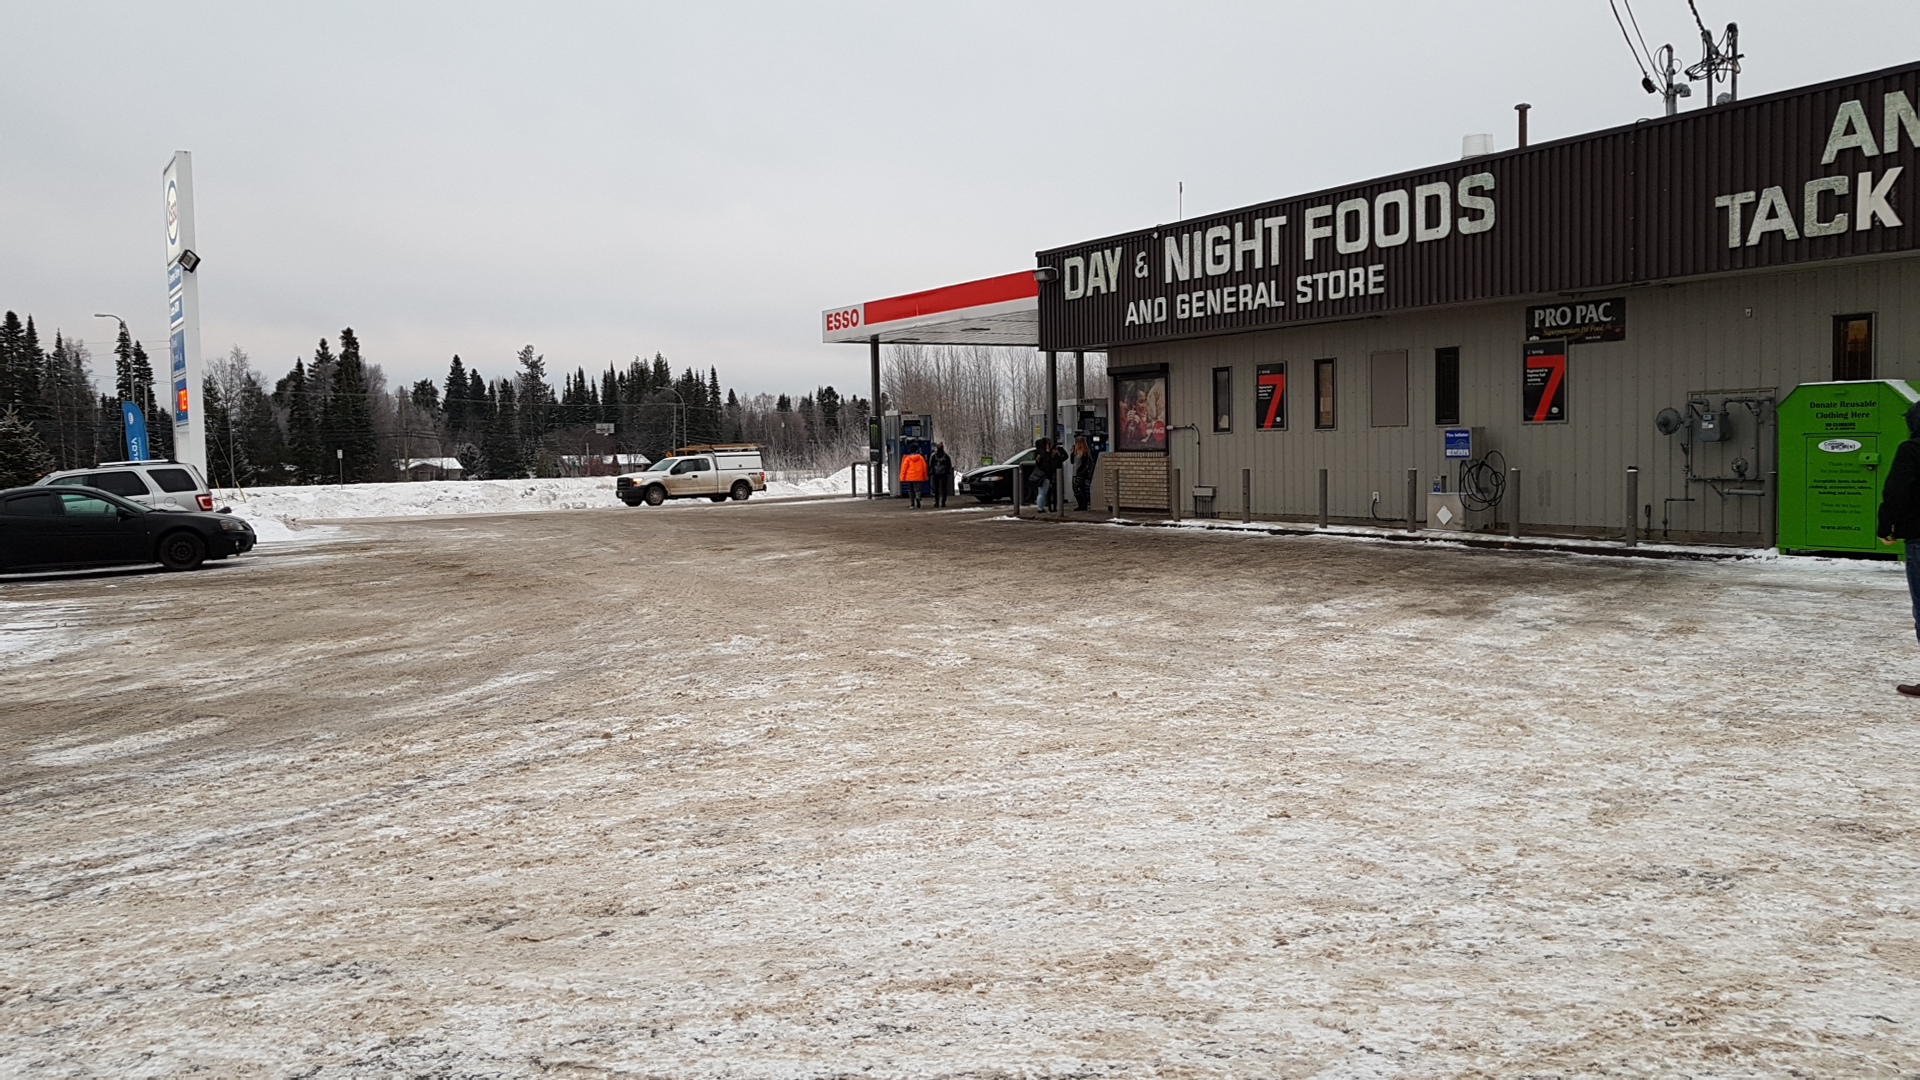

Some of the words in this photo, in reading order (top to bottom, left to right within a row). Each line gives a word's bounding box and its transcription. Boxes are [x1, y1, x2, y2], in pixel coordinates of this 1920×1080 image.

[1064, 246, 1123, 301] DAY
[1134, 251, 1149, 279] &
[1164, 215, 1287, 284] NIGHT
[1304, 171, 1496, 261] FOODS
[1714, 166, 1904, 249] TACK
[826, 308, 860, 332] ESSO
[1125, 296, 1167, 327] AND
[1176, 280, 1285, 320] GENERAL
[1296, 263, 1385, 303] STORE
[1534, 306, 1572, 328] PRO
[1576, 302, 1613, 324] PAC
[1542, 326, 1580, 336] Superpremium
[1259, 374, 1286, 430] 7
[1527, 354, 1566, 422] 7
